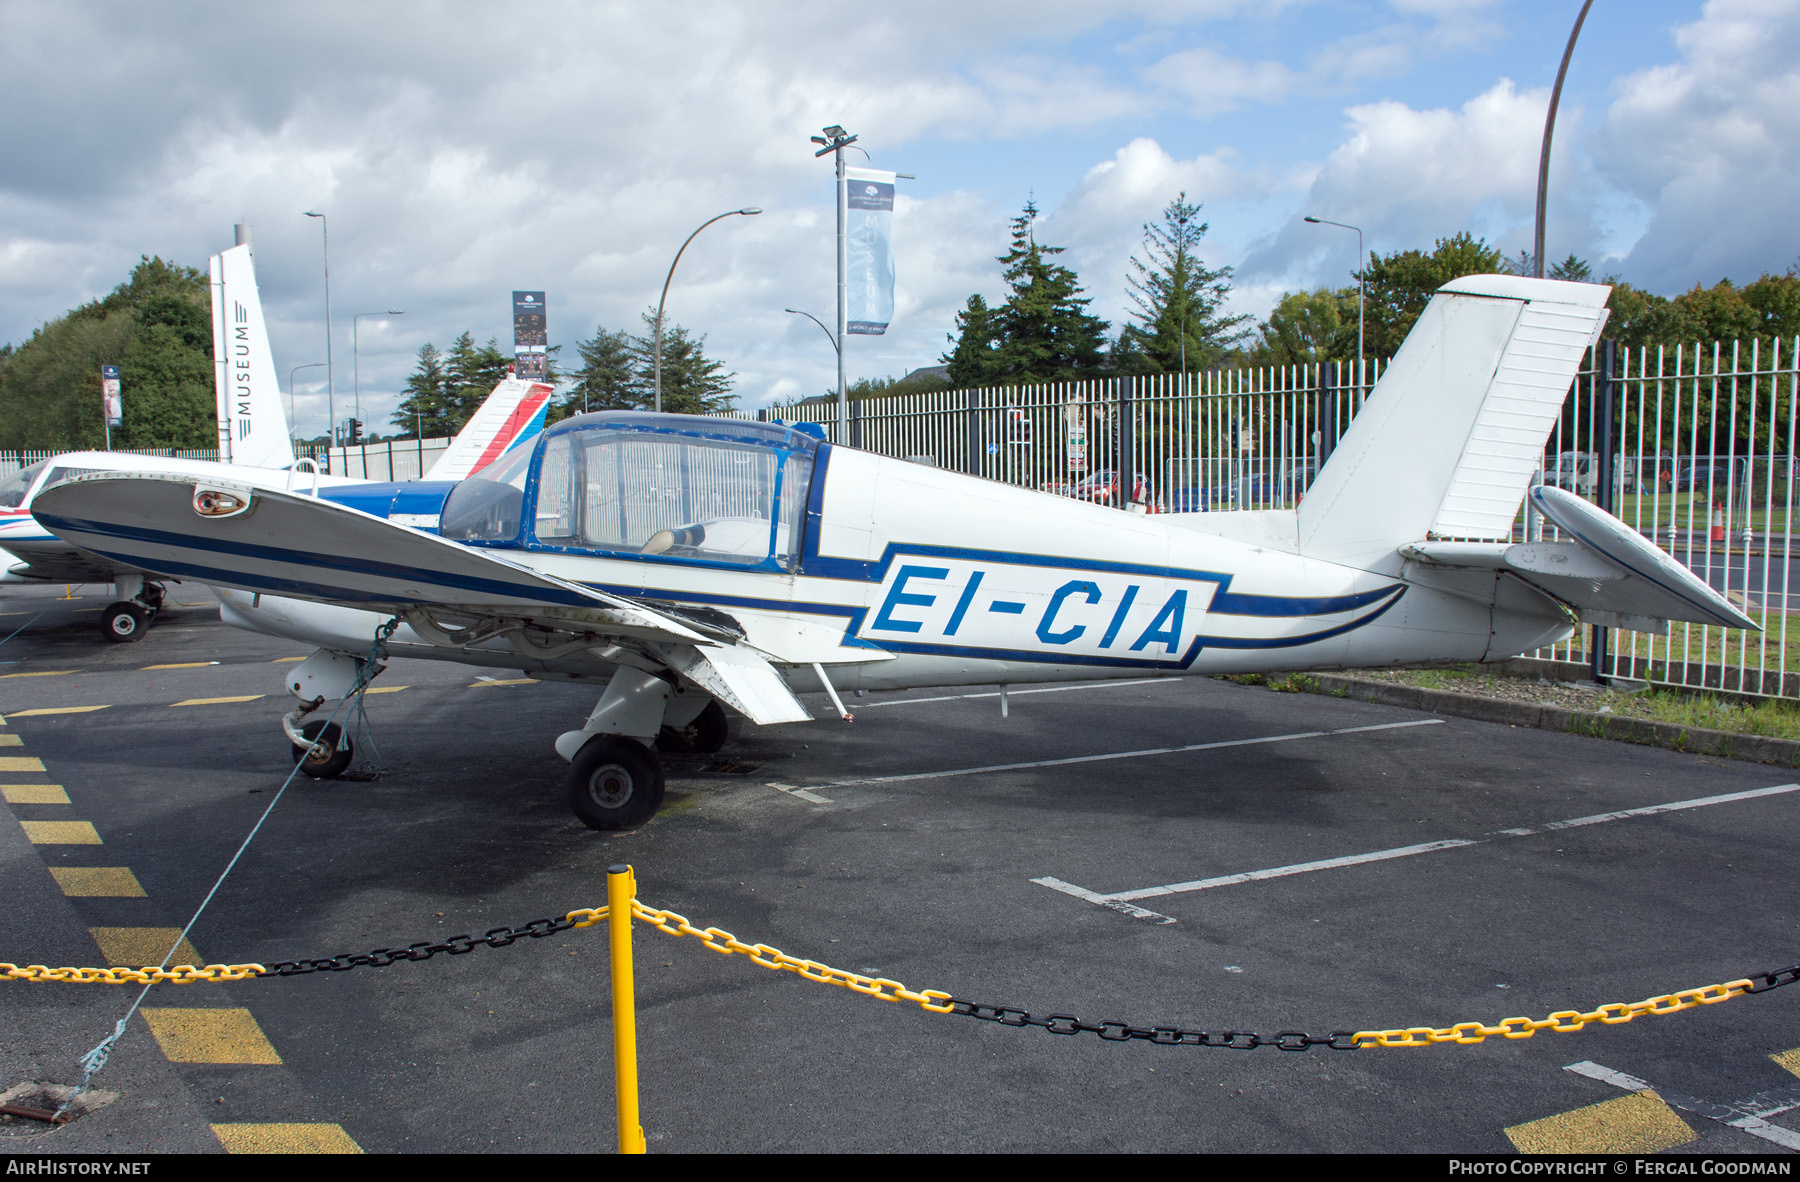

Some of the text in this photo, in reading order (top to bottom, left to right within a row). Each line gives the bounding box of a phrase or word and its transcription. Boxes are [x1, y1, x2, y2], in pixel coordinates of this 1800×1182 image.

[865, 214, 879, 315] MUSEUM
[235, 326, 252, 416] MUSEUM
[871, 564, 1188, 654] EI-CIA
